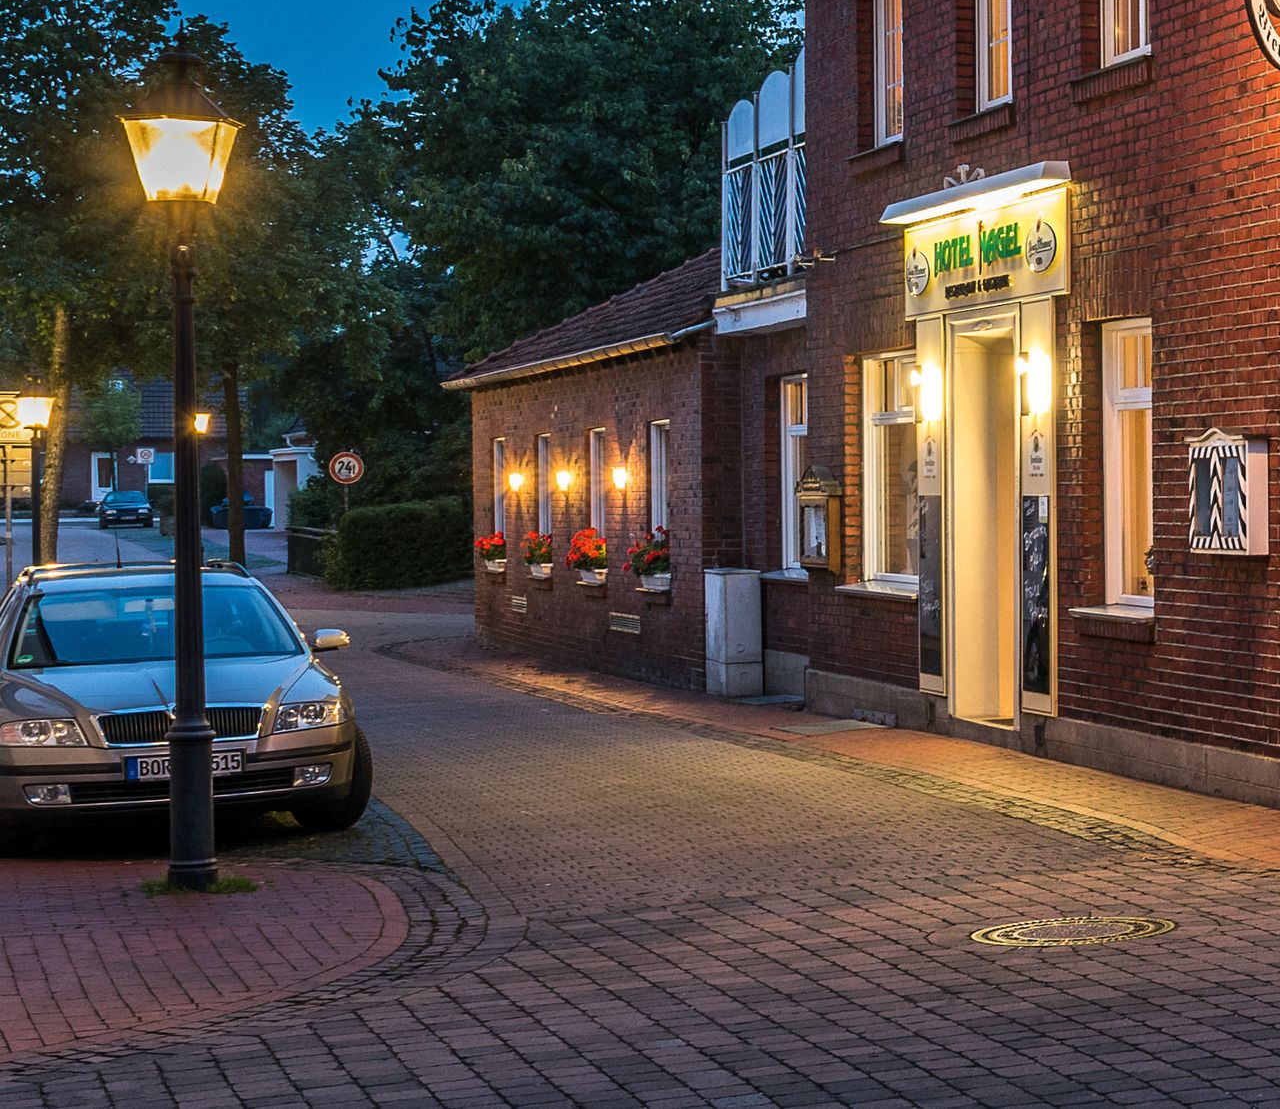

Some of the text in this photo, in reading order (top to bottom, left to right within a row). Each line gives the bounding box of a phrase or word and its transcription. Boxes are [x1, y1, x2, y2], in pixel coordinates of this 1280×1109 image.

[934, 234, 974, 277] HOTEL
[979, 221, 1022, 275] NAGEL
[0, 431, 20, 439] ONE
[140, 759, 170, 776] BOR
